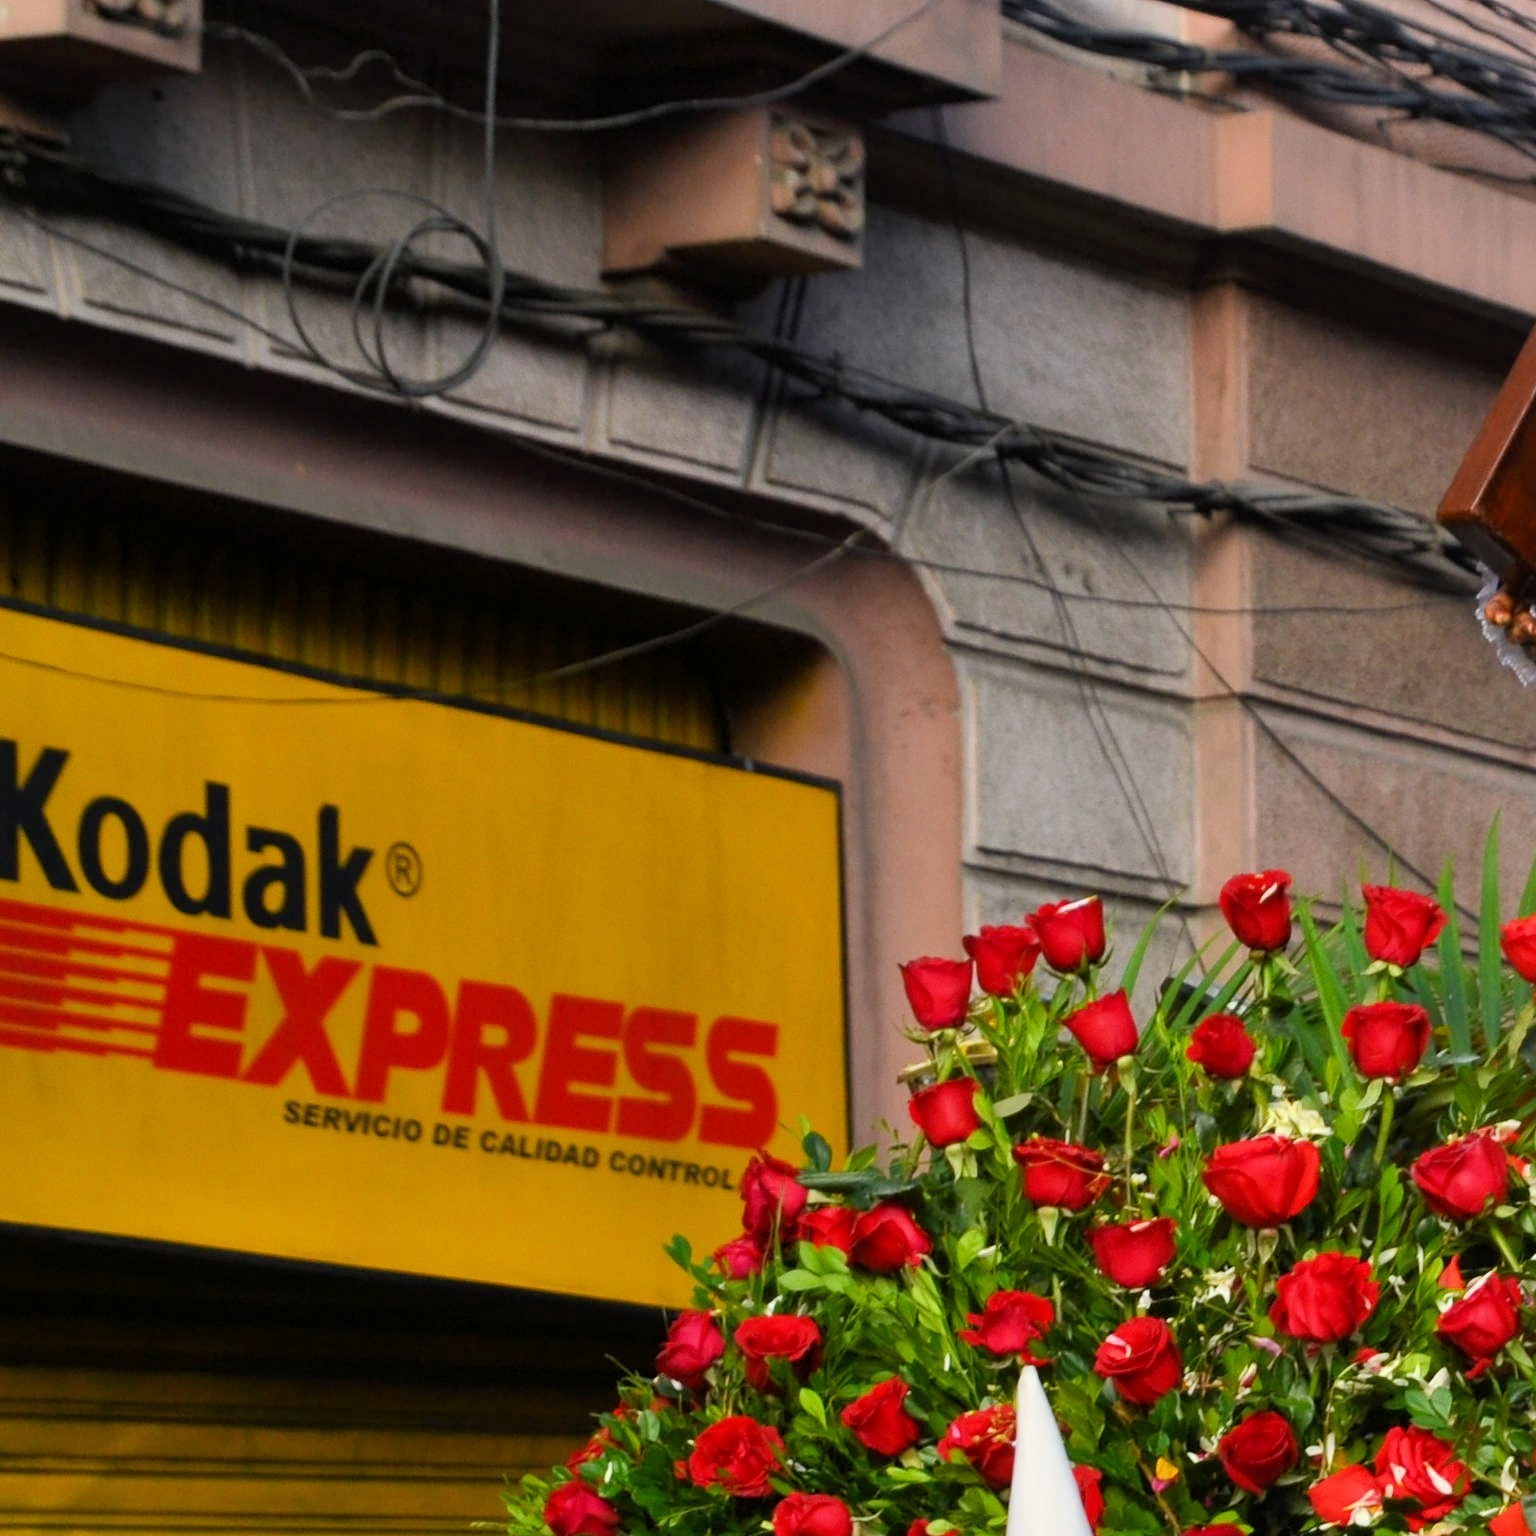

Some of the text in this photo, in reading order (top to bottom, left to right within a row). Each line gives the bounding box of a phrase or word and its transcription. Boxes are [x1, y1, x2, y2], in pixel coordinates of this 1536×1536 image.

[0, 738, 380, 948] Kodak
[152, 932, 780, 1150] EXPRESS
[283, 1100, 735, 1191] SERVICIO DE CALIDAD CONTROL
